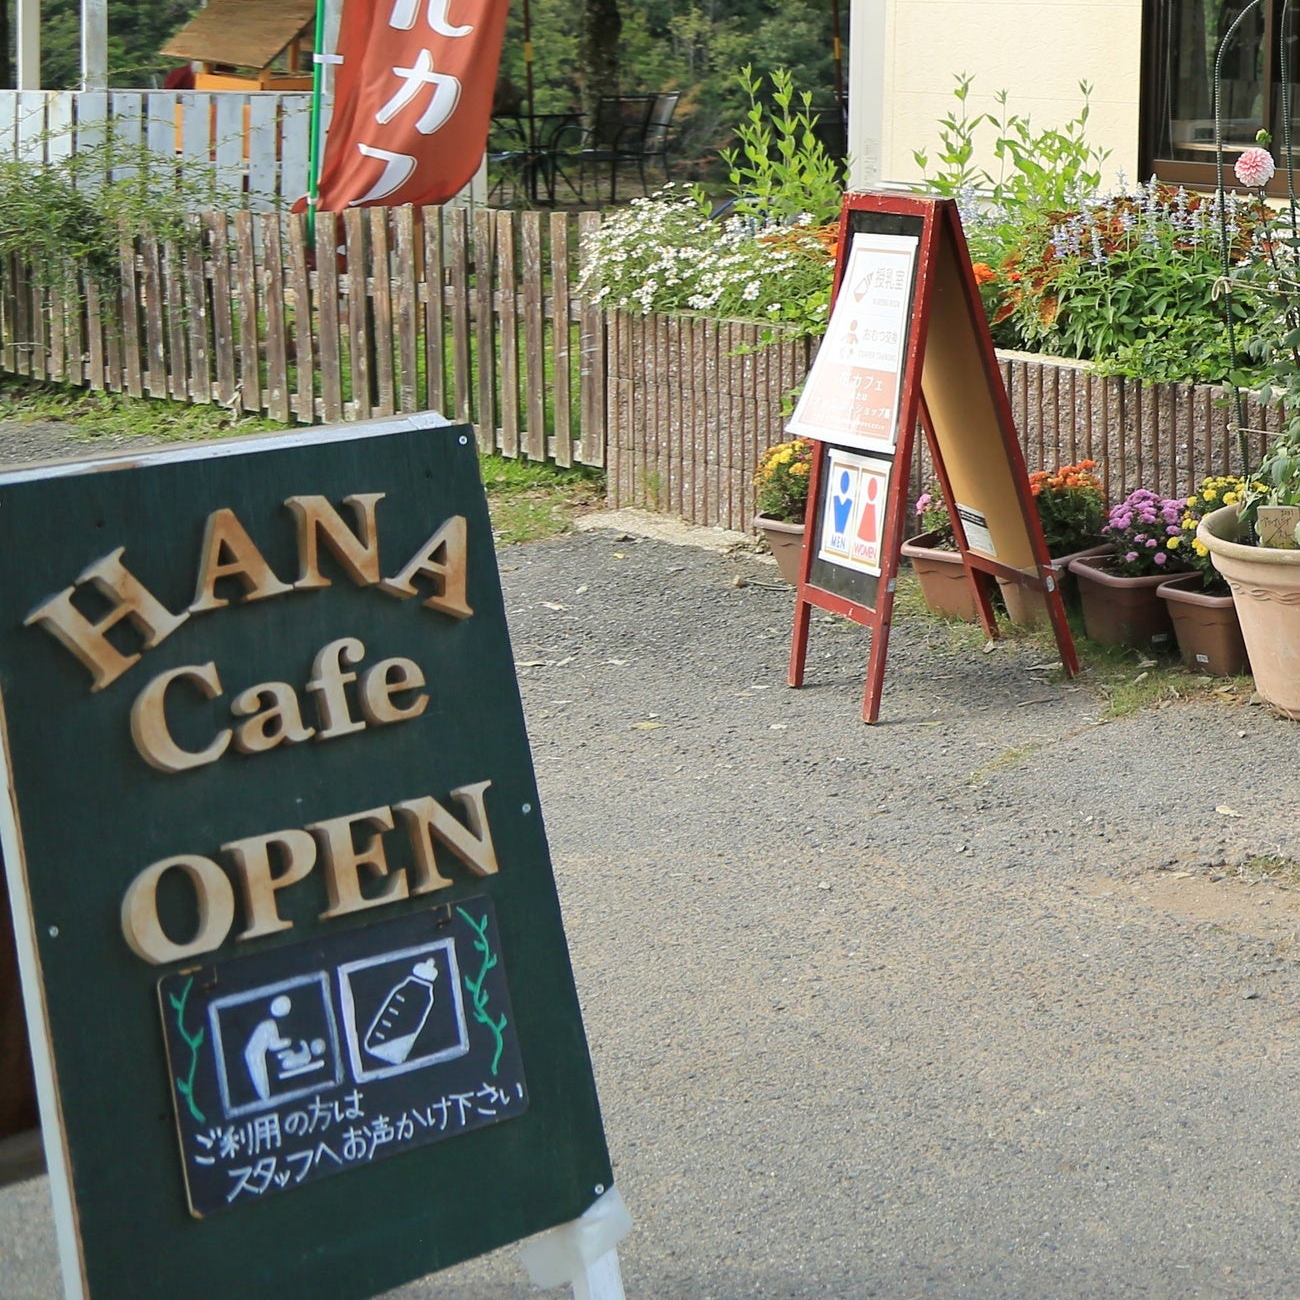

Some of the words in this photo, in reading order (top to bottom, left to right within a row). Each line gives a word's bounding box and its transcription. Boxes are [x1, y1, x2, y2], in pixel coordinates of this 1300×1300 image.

[873, 267, 905, 290] 授乳室
[830, 534, 846, 550] MEN
[855, 542, 877, 560] WOMEN
[23, 491, 474, 693] HANA
[129, 637, 430, 774] Cafe
[121, 780, 499, 966] OPEN
[194, 1088, 364, 1164] ご利用の方は
[227, 1082, 525, 1202] スタッフへお声かけ下さい
